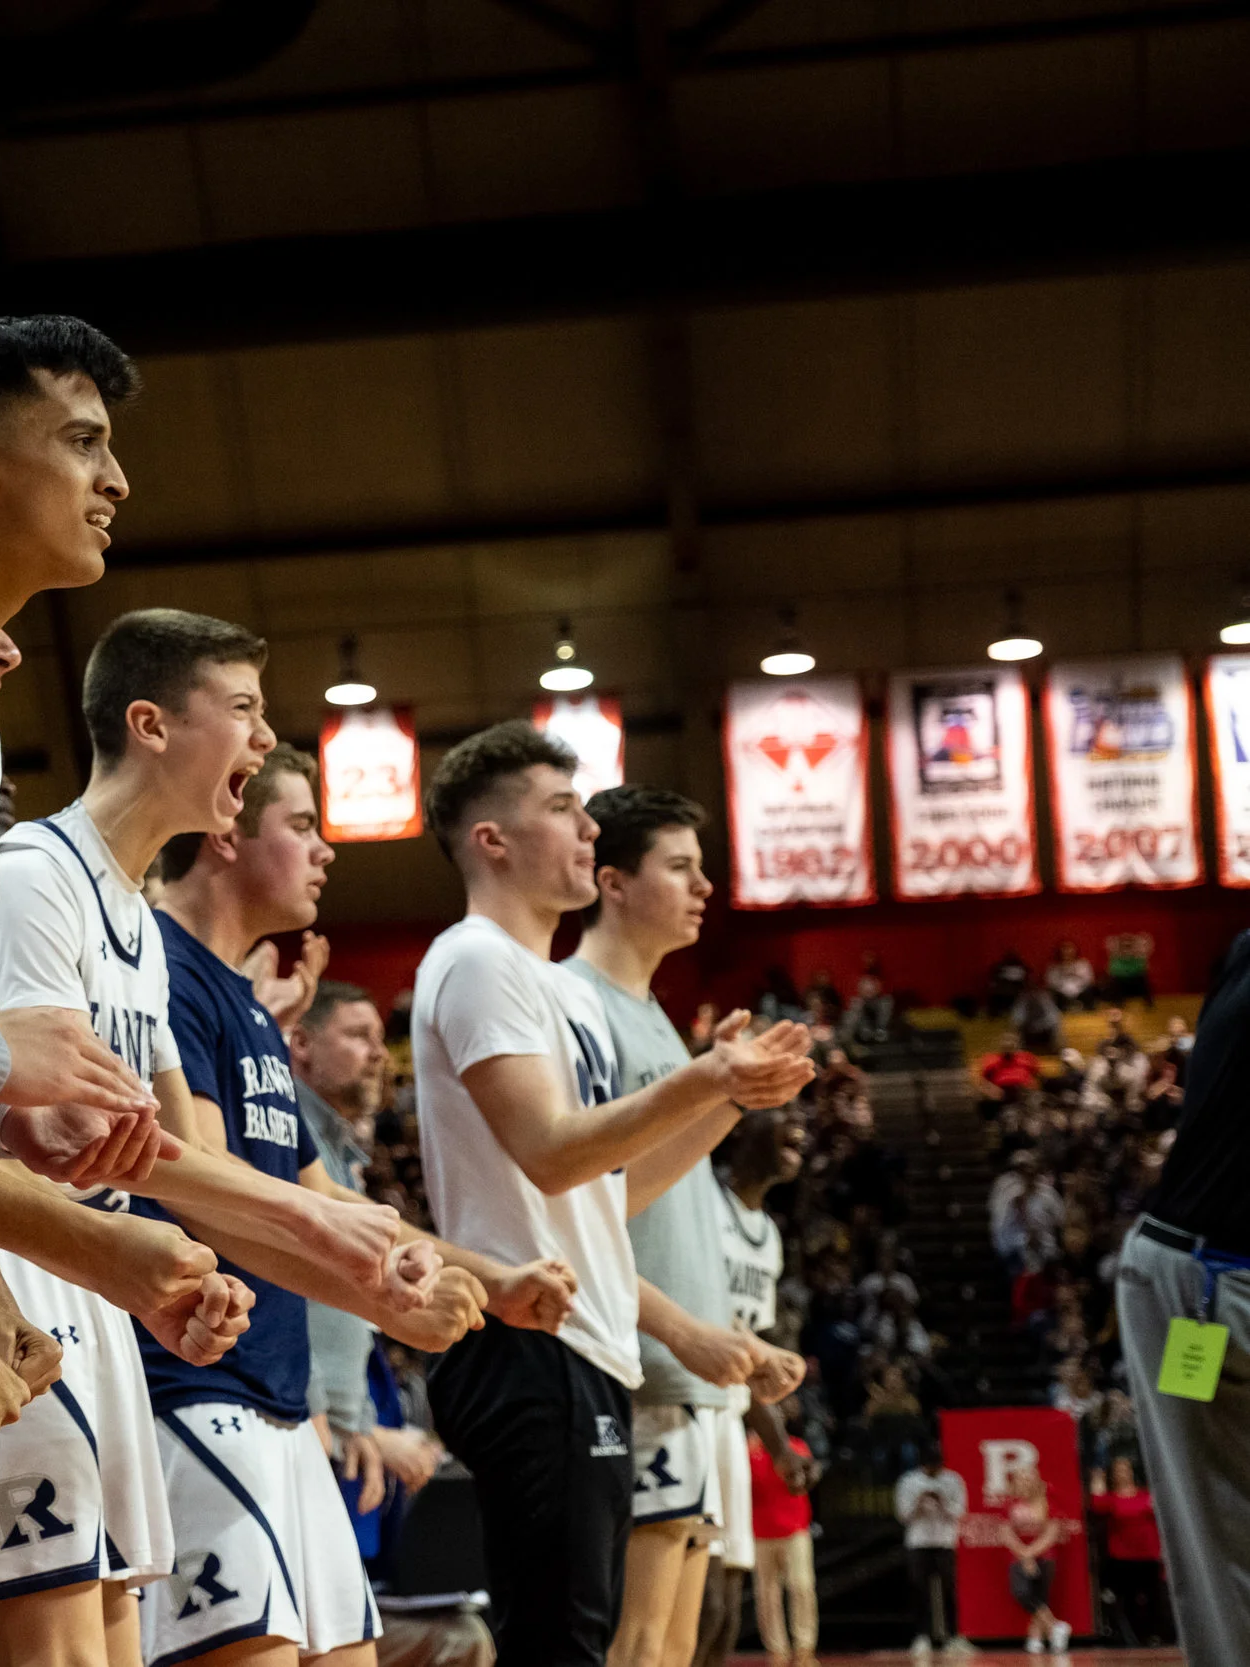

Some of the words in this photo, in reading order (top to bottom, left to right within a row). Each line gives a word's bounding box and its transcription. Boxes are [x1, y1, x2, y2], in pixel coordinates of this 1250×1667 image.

[342, 763, 404, 799] 23
[909, 834, 1021, 870] 2000
[1073, 824, 1184, 863] 2007
[167, 1551, 240, 1622] R
